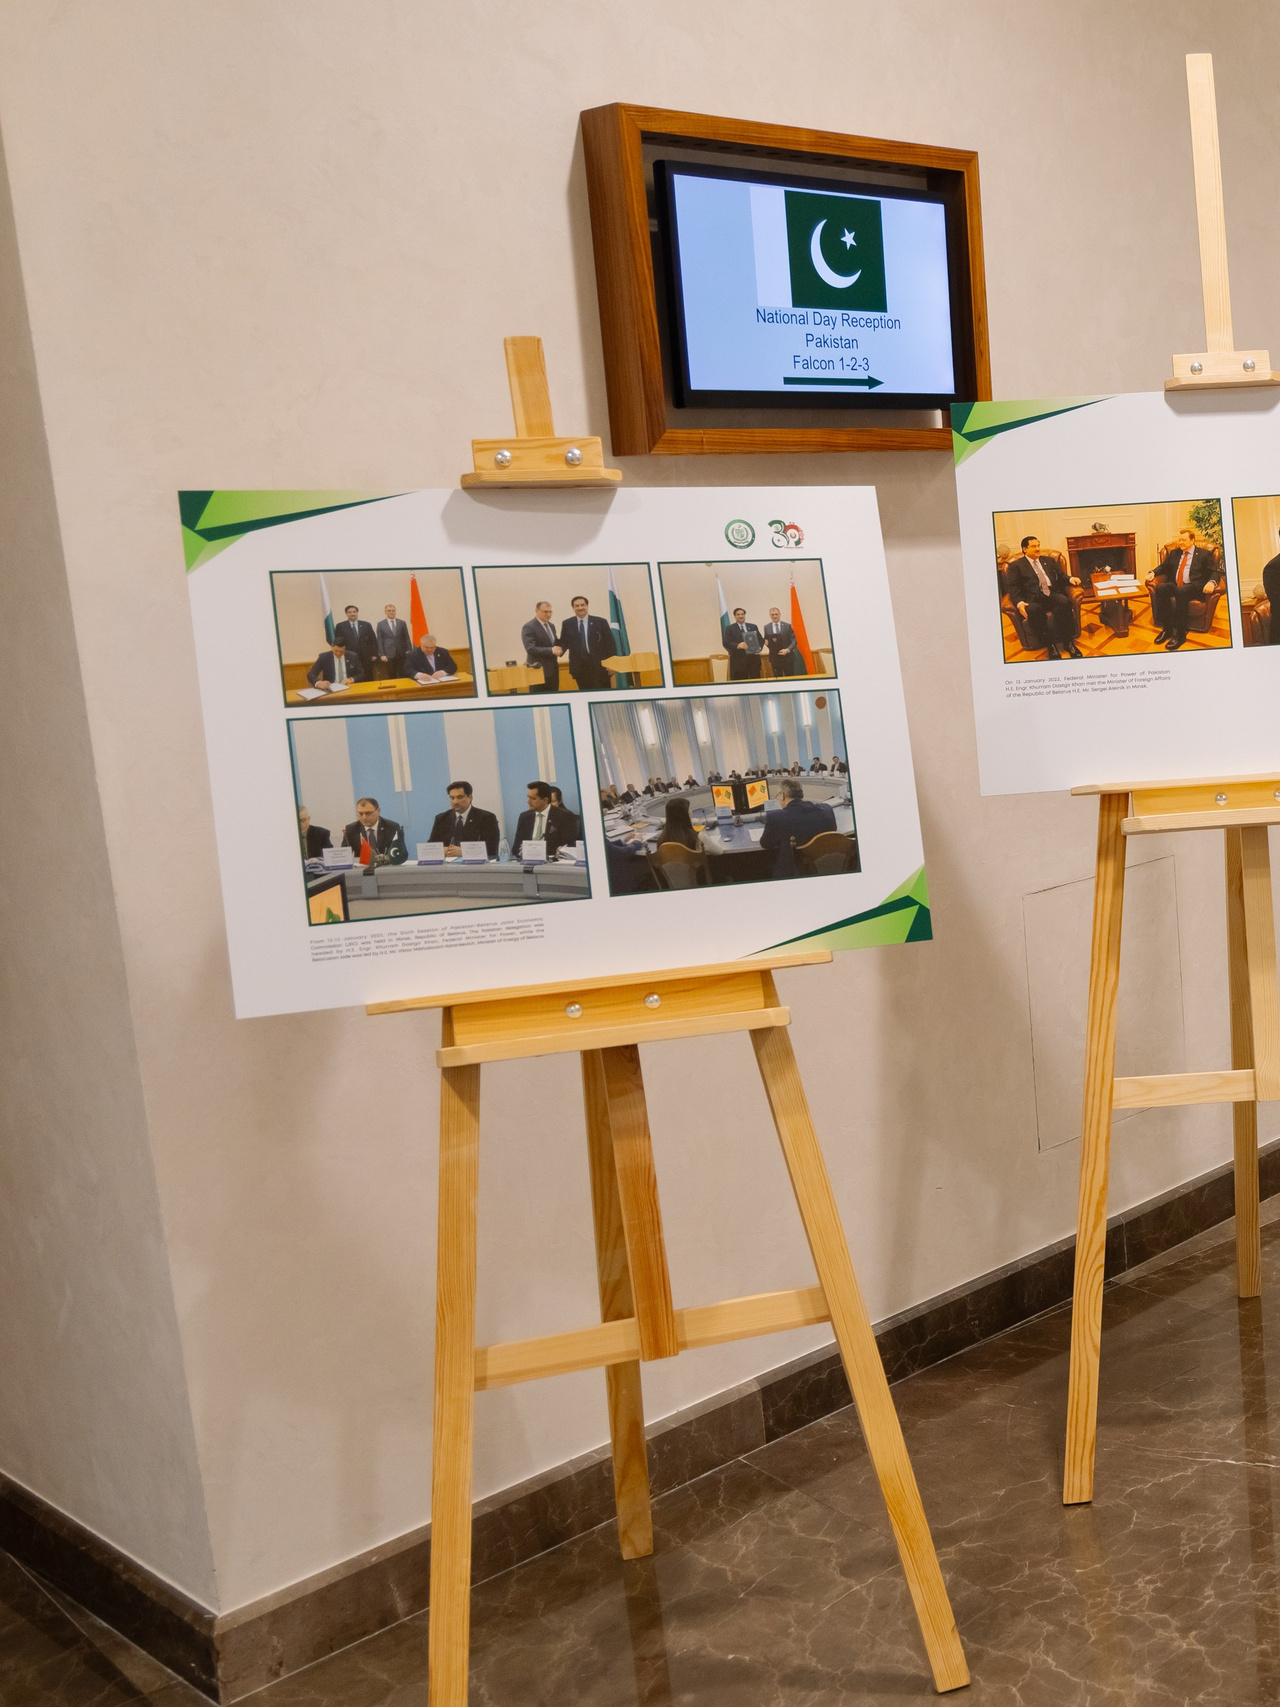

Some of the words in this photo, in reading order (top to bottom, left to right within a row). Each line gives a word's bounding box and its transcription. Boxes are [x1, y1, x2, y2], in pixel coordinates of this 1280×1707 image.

[756, 308, 809, 326] National
[813, 312, 837, 330] Day
[841, 313, 901, 332] Reception
[805, 333, 858, 349] Pakistan
[793, 355, 835, 371] Falcon
[839, 357, 870, 372] 1-2-3
